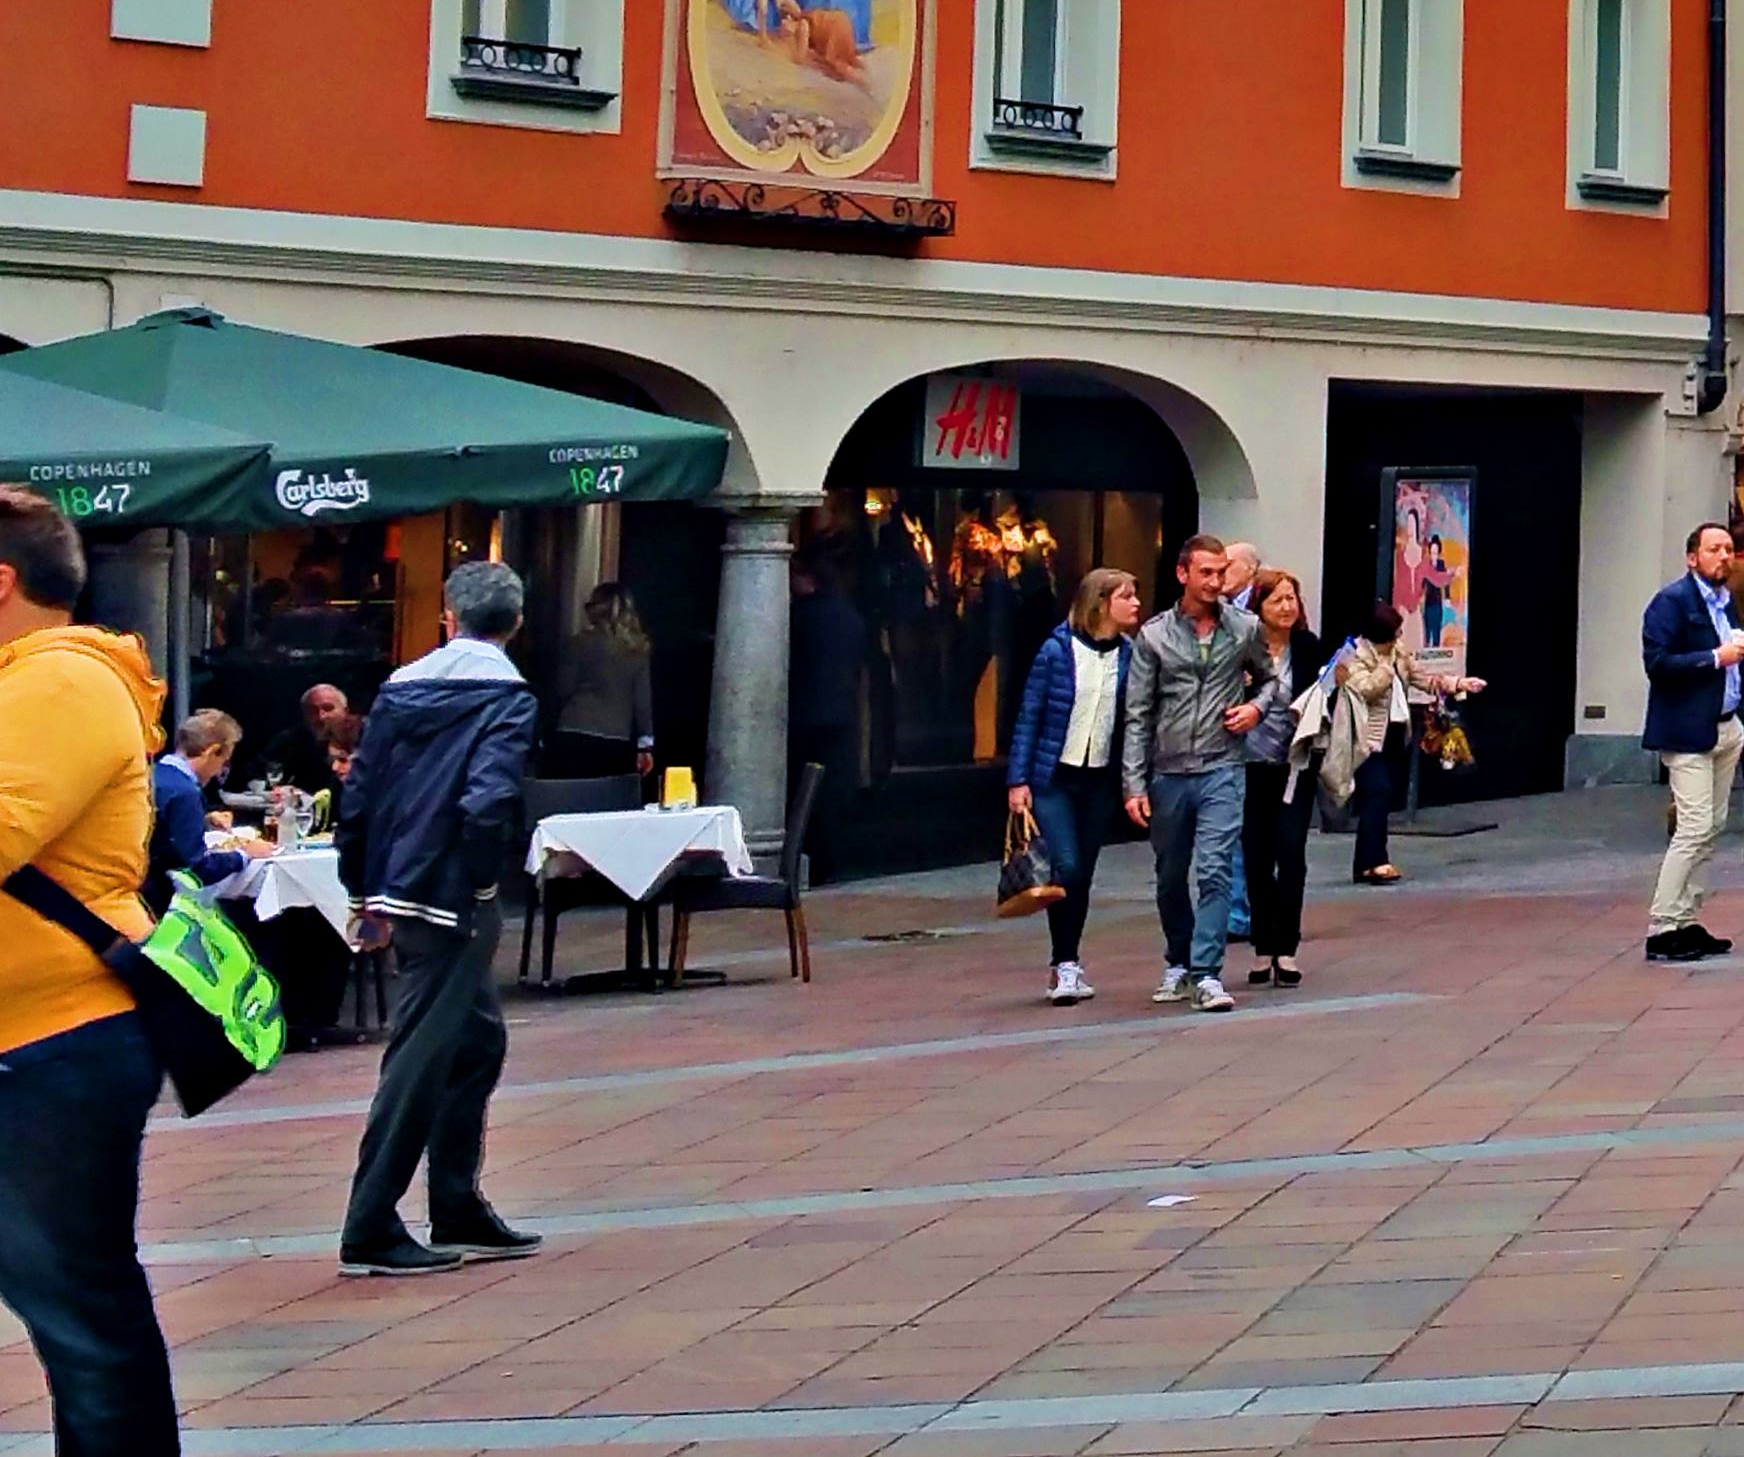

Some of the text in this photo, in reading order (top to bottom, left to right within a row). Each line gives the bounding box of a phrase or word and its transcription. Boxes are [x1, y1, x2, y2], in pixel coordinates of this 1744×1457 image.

[935, 380, 1018, 460] H&M
[549, 444, 640, 463] COPENHAGEN
[29, 460, 151, 481] COPENHAGEN
[569, 464, 625, 495] 1847
[56, 483, 131, 518] 1847
[275, 468, 371, 517] Carlsberg
